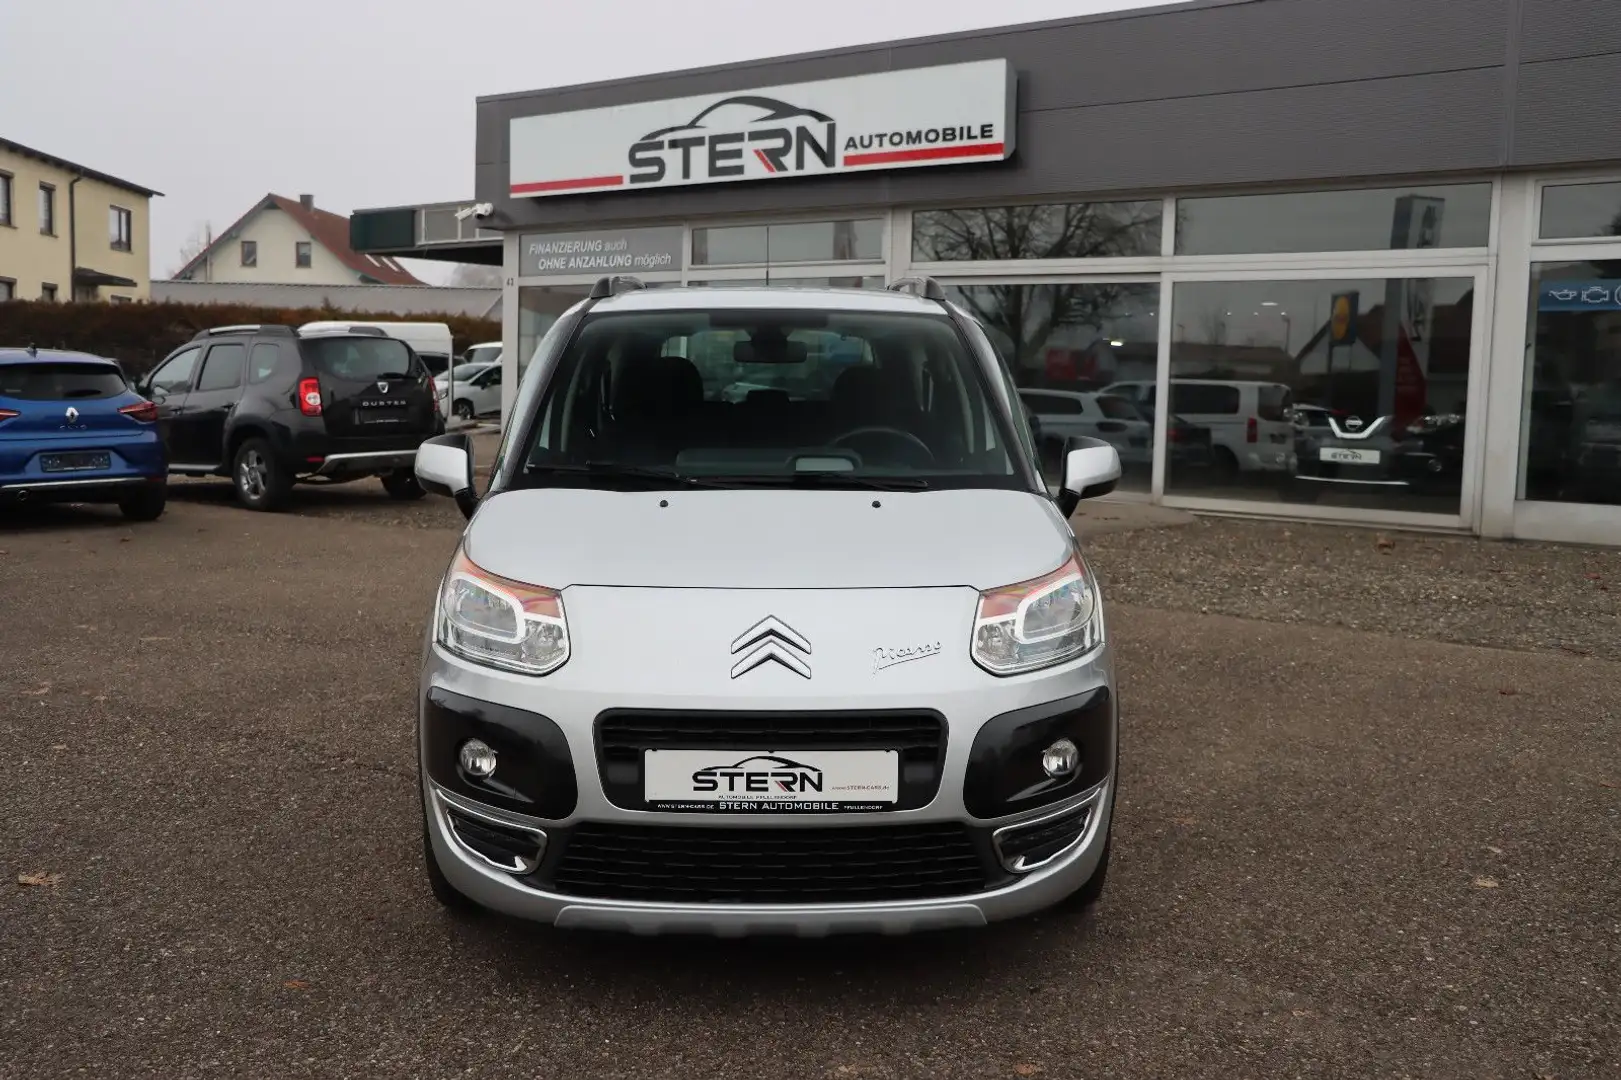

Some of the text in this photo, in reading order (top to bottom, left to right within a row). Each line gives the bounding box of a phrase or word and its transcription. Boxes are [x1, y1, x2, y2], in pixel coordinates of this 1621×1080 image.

[628, 121, 994, 184] STERN AUTOMOBILE
[529, 238, 628, 255] FINANZIERUNG auch
[538, 252, 672, 270] OHNE ANZAHLUNG möglich
[692, 771, 823, 792] STERN
[719, 801, 758, 810] STERN
[761, 801, 840, 810] AUTOMOBILE
